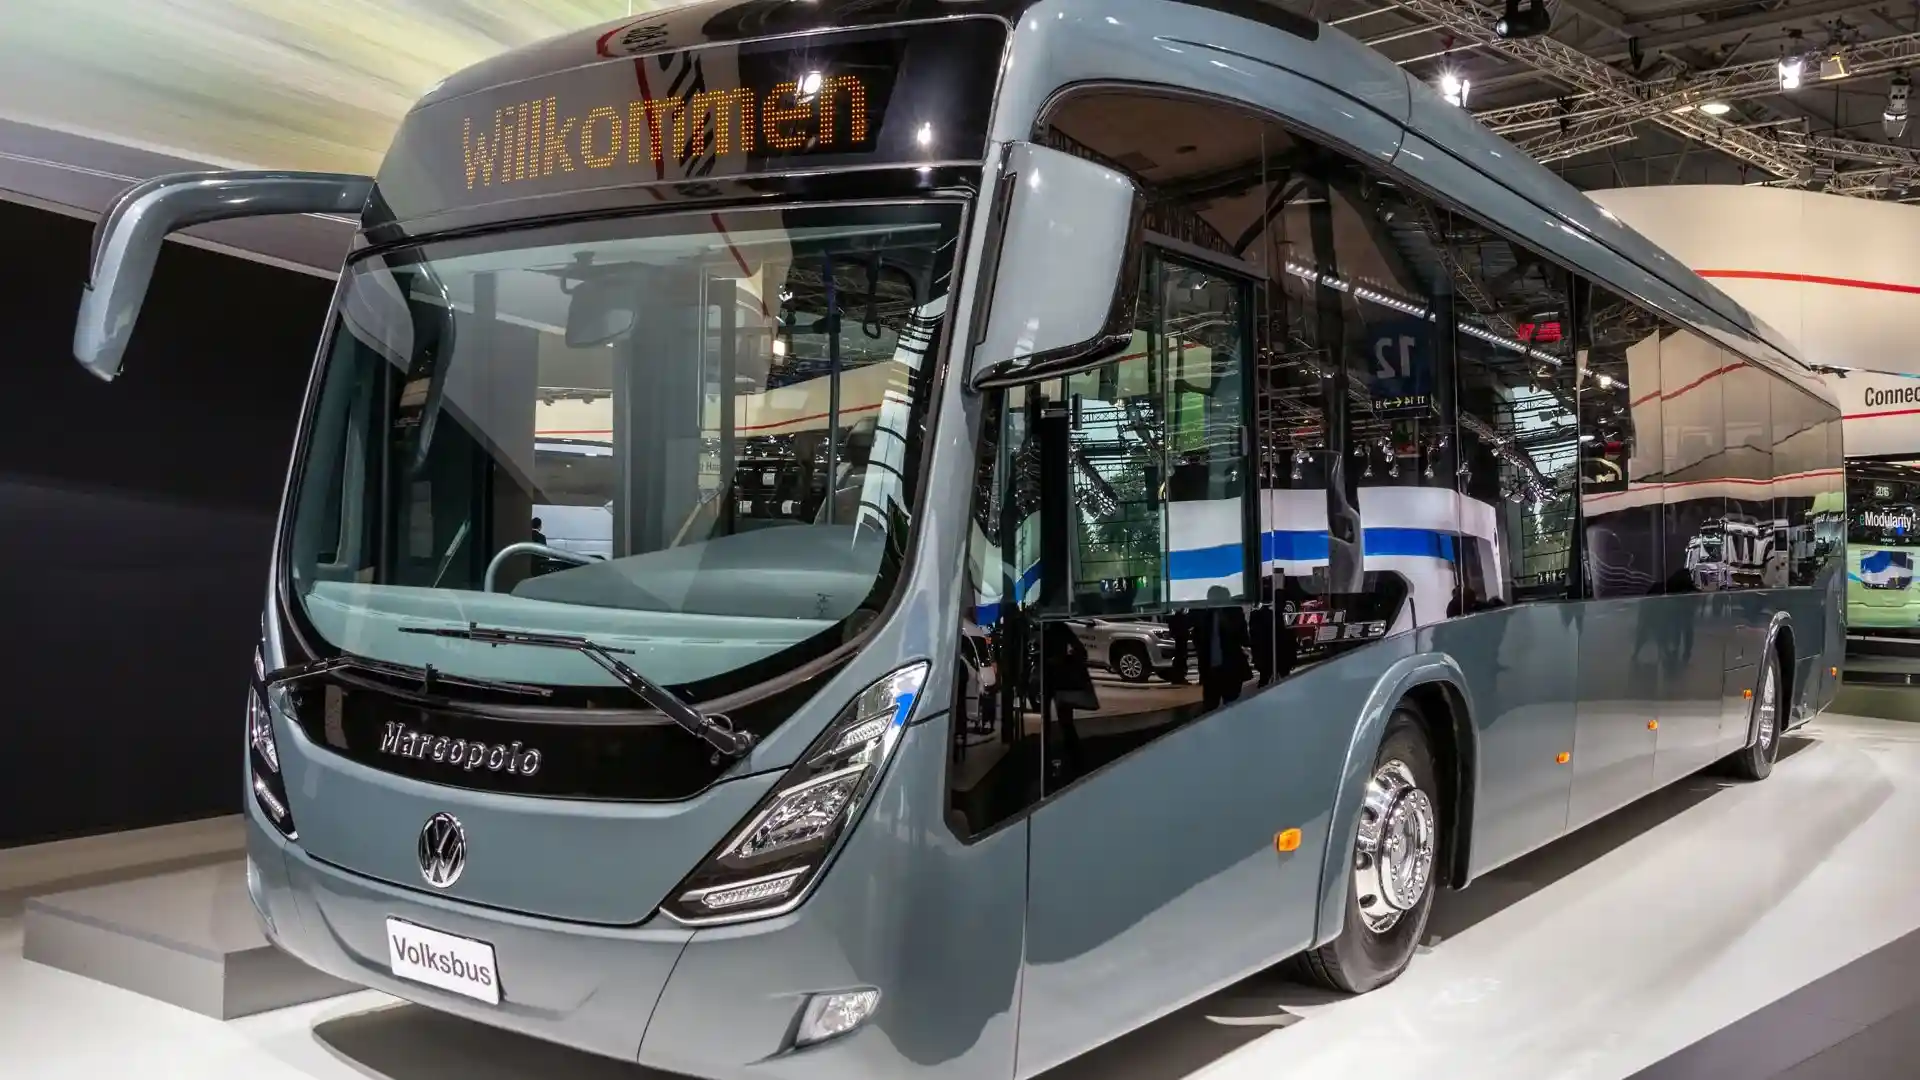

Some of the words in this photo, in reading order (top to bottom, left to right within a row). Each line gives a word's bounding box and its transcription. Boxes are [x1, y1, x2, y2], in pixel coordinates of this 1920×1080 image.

[1860, 511, 1912, 531] eModularity
[380, 720, 542, 776] Marcopolo
[392, 934, 492, 986] Volksbus
